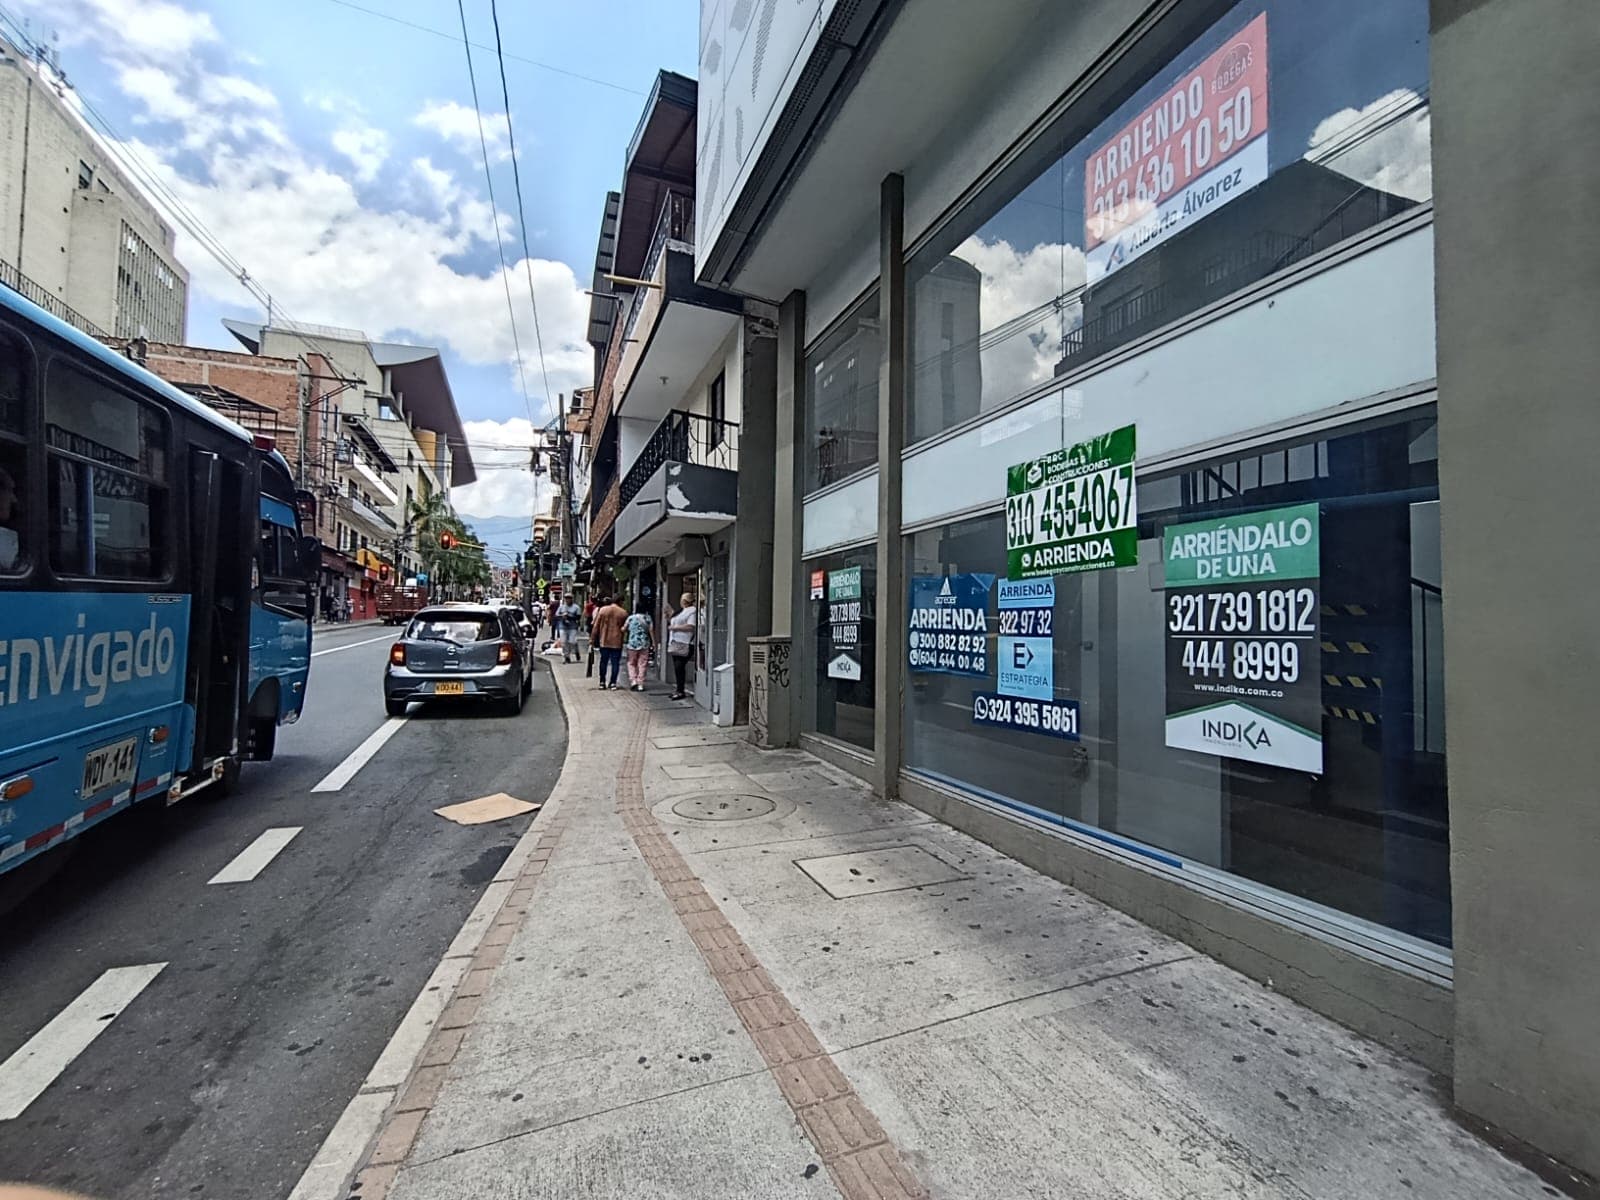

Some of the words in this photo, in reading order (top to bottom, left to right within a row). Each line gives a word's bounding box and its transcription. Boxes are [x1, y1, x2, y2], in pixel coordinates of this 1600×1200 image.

[1211, 52, 1253, 95] BODEGAS
[1094, 76, 1203, 193] ARRIENDO
[1135, 146, 1175, 204] 636
[1181, 118, 1212, 178] 10
[1218, 86, 1252, 153] 50
[1181, 166, 1243, 219] Álvarez
[1007, 493, 1035, 548] 310
[1040, 464, 1134, 541] 4554067
[1033, 538, 1115, 567] ARRIENDA
[1170, 517, 1312, 560] ARRIÉNDALO
[1197, 558, 1222, 580] DE
[1227, 552, 1277, 577] UNA
[1000, 583, 1053, 598] ARRIENDA
[909, 608, 987, 631] ARRIENDA
[999, 611, 1018, 634] 322
[1020, 610, 1035, 634] 97
[1037, 610, 1052, 634] 32
[1169, 594, 1204, 632] 321
[1208, 591, 1253, 632] 739
[1257, 588, 1316, 632] 1812
[0, 611, 175, 708] nvigado
[919, 633, 936, 649] 300
[938, 634, 956, 651] 882
[958, 635, 970, 652] 82
[972, 636, 986, 654] 92
[958, 655, 970, 669] 00
[972, 657, 985, 672] 48
[1182, 640, 1226, 678] 444
[1233, 641, 1299, 683] 8999
[1001, 672, 1049, 687] ESTRATEGIA
[1194, 683, 1284, 698] www.indika.com.co
[988, 699, 1012, 722] 324
[1014, 701, 1040, 727] 395
[1042, 704, 1077, 734] 5861
[1202, 719, 1272, 750] INDIKA
